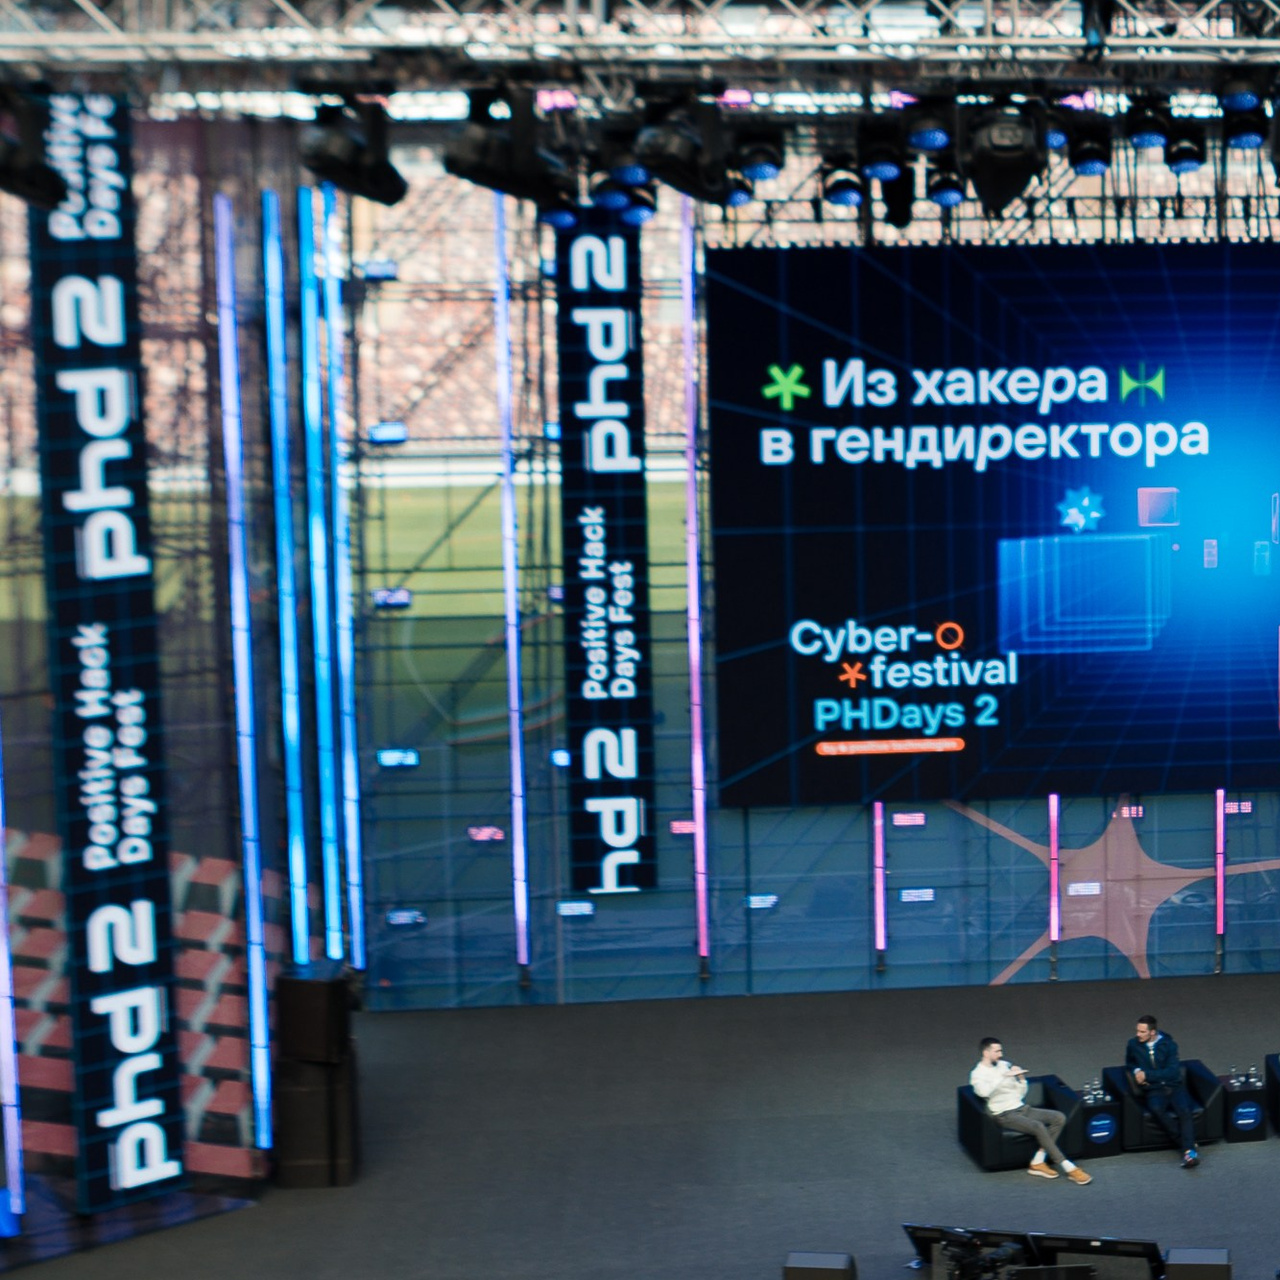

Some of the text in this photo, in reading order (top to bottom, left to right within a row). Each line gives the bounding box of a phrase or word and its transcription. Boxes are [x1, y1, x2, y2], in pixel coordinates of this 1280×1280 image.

[51, 275, 151, 579] phd 2
[570, 235, 642, 473] phd 2
[823, 358, 1108, 414] Из хакера
[761, 422, 1210, 471] в гендиректора
[578, 506, 609, 700] Positive Hack
[608, 560, 641, 699] Days Fest
[790, 620, 932, 661] Cyber-
[870, 651, 1018, 688] festival
[71, 622, 119, 871] Positive Hack
[111, 687, 157, 864] Days Fest
[814, 694, 999, 736] PHDays 2
[583, 727, 645, 894] hd 2
[87, 899, 182, 1191] phd 2
